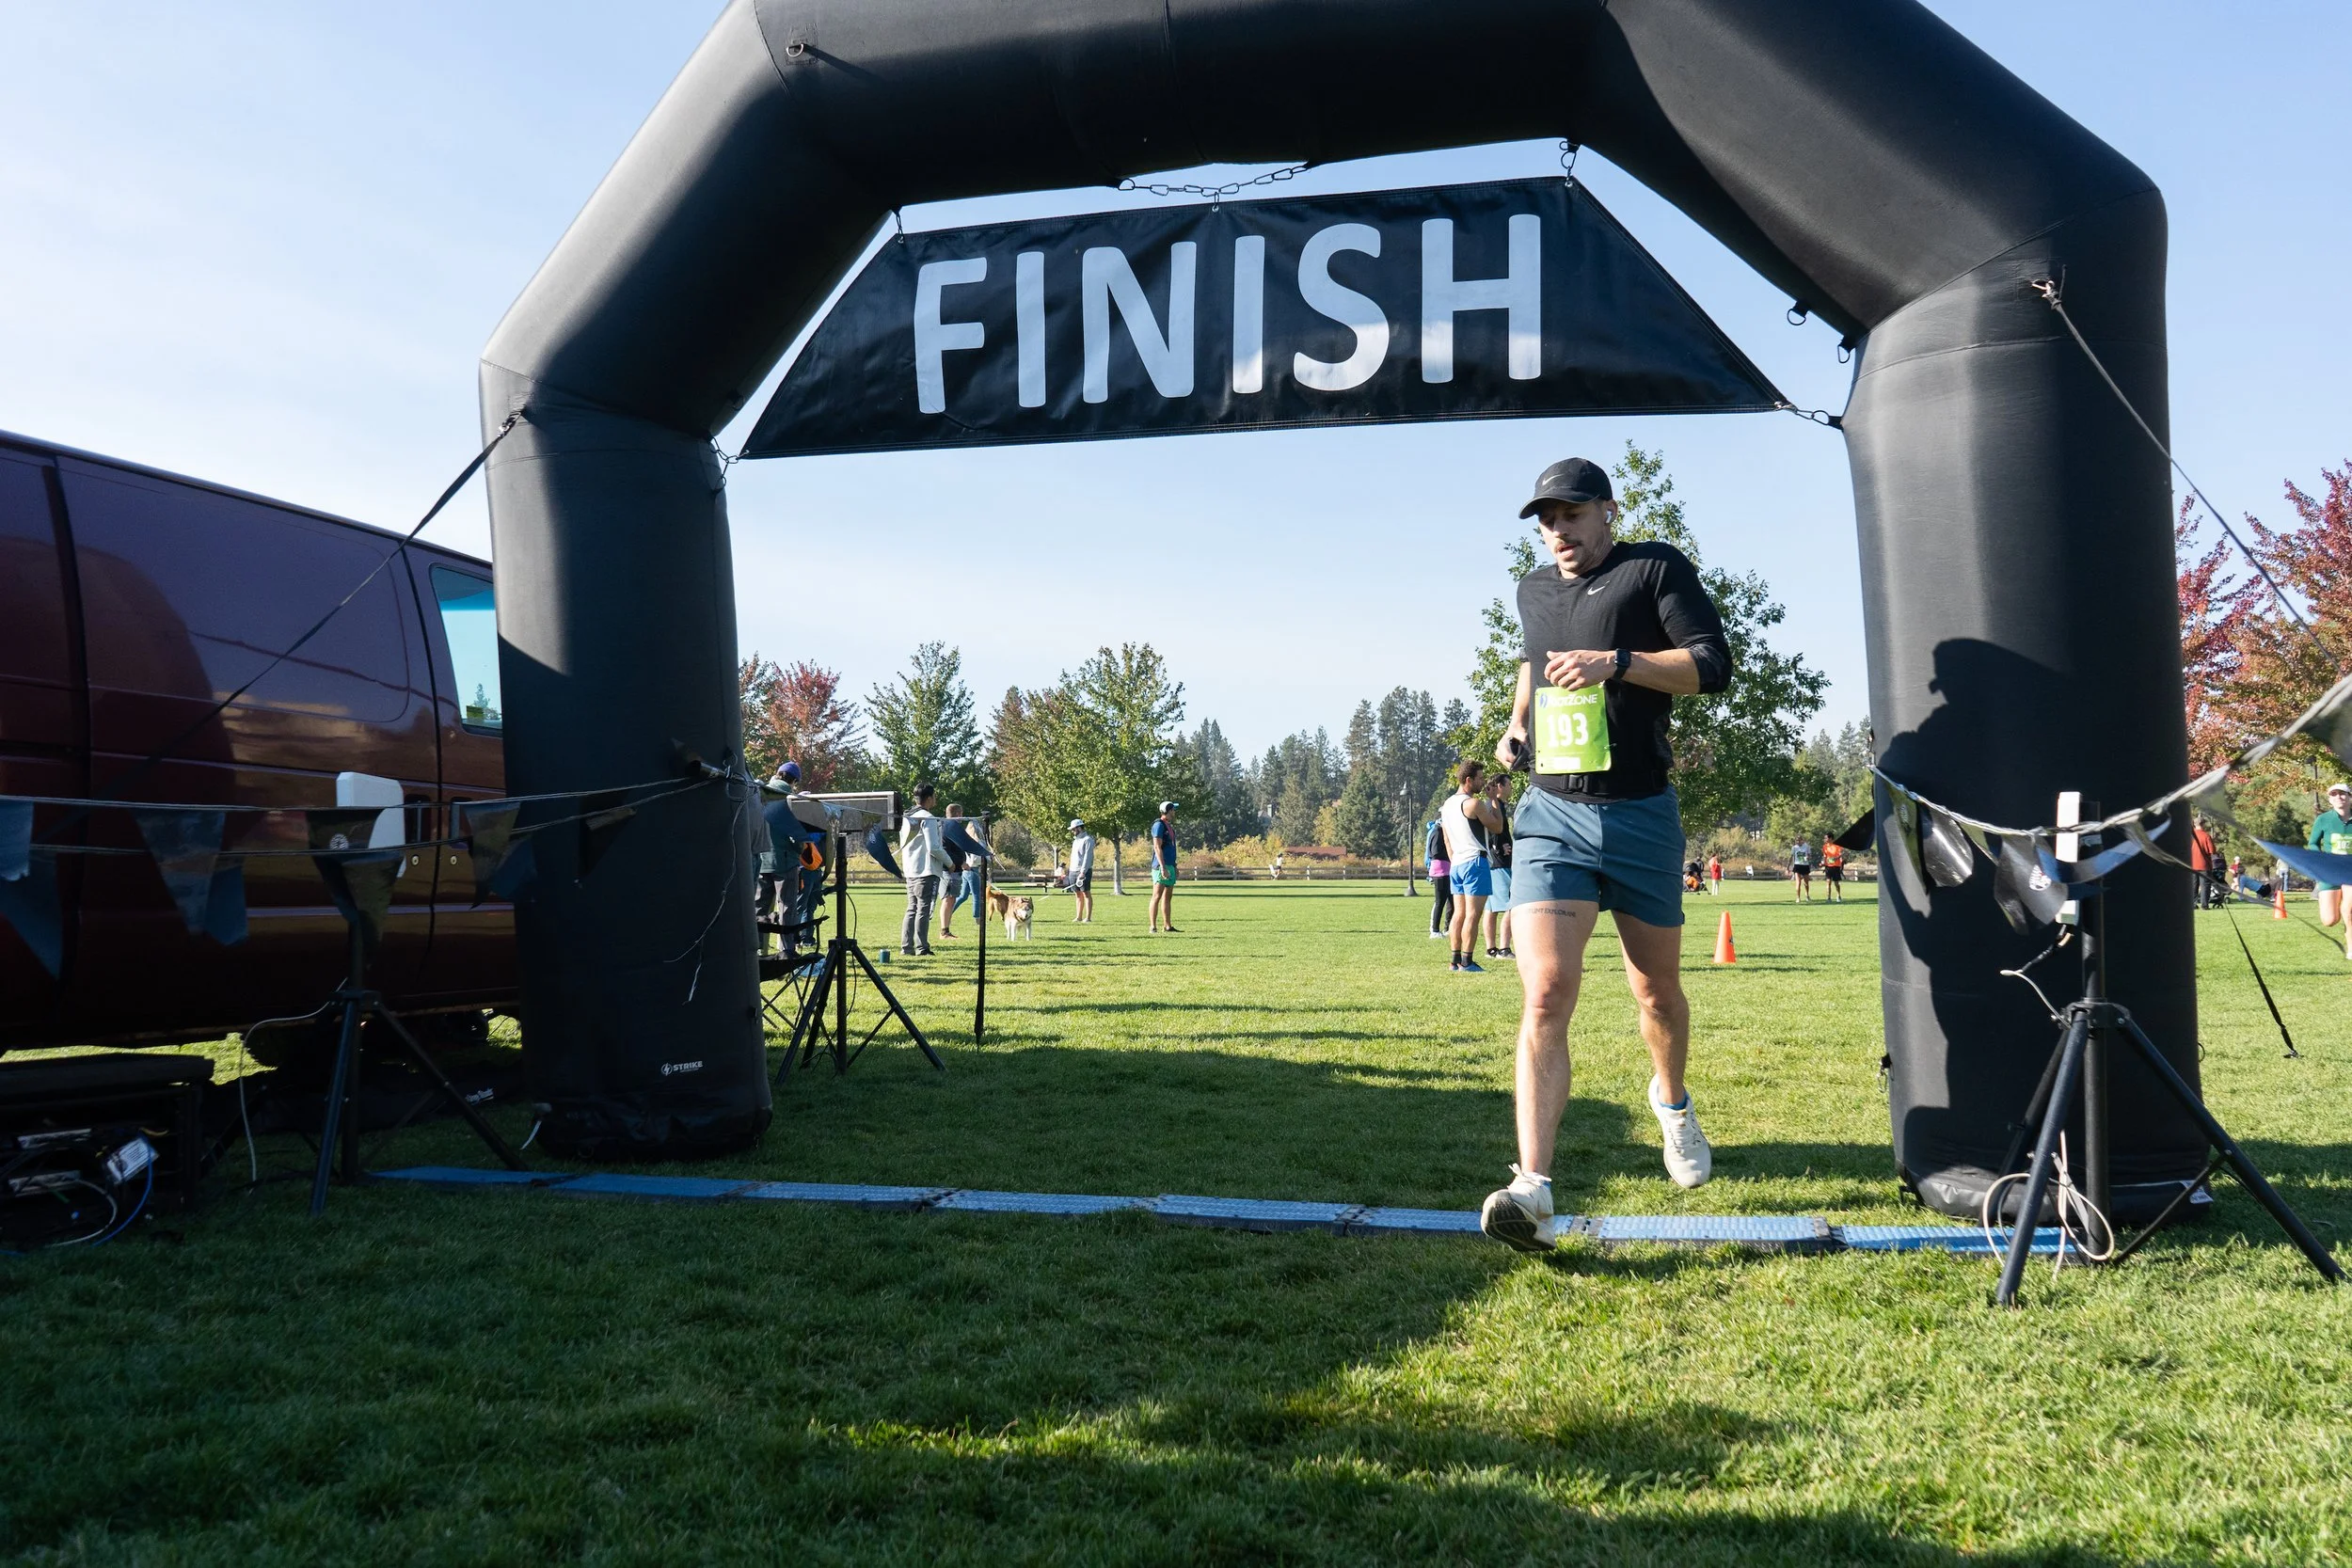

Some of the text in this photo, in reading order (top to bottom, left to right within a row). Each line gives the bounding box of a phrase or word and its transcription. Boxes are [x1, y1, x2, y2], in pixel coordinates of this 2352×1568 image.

[914, 214, 1541, 414] FINISH
[1547, 713, 1589, 748] 193
[673, 1060, 703, 1071] STRIKE
